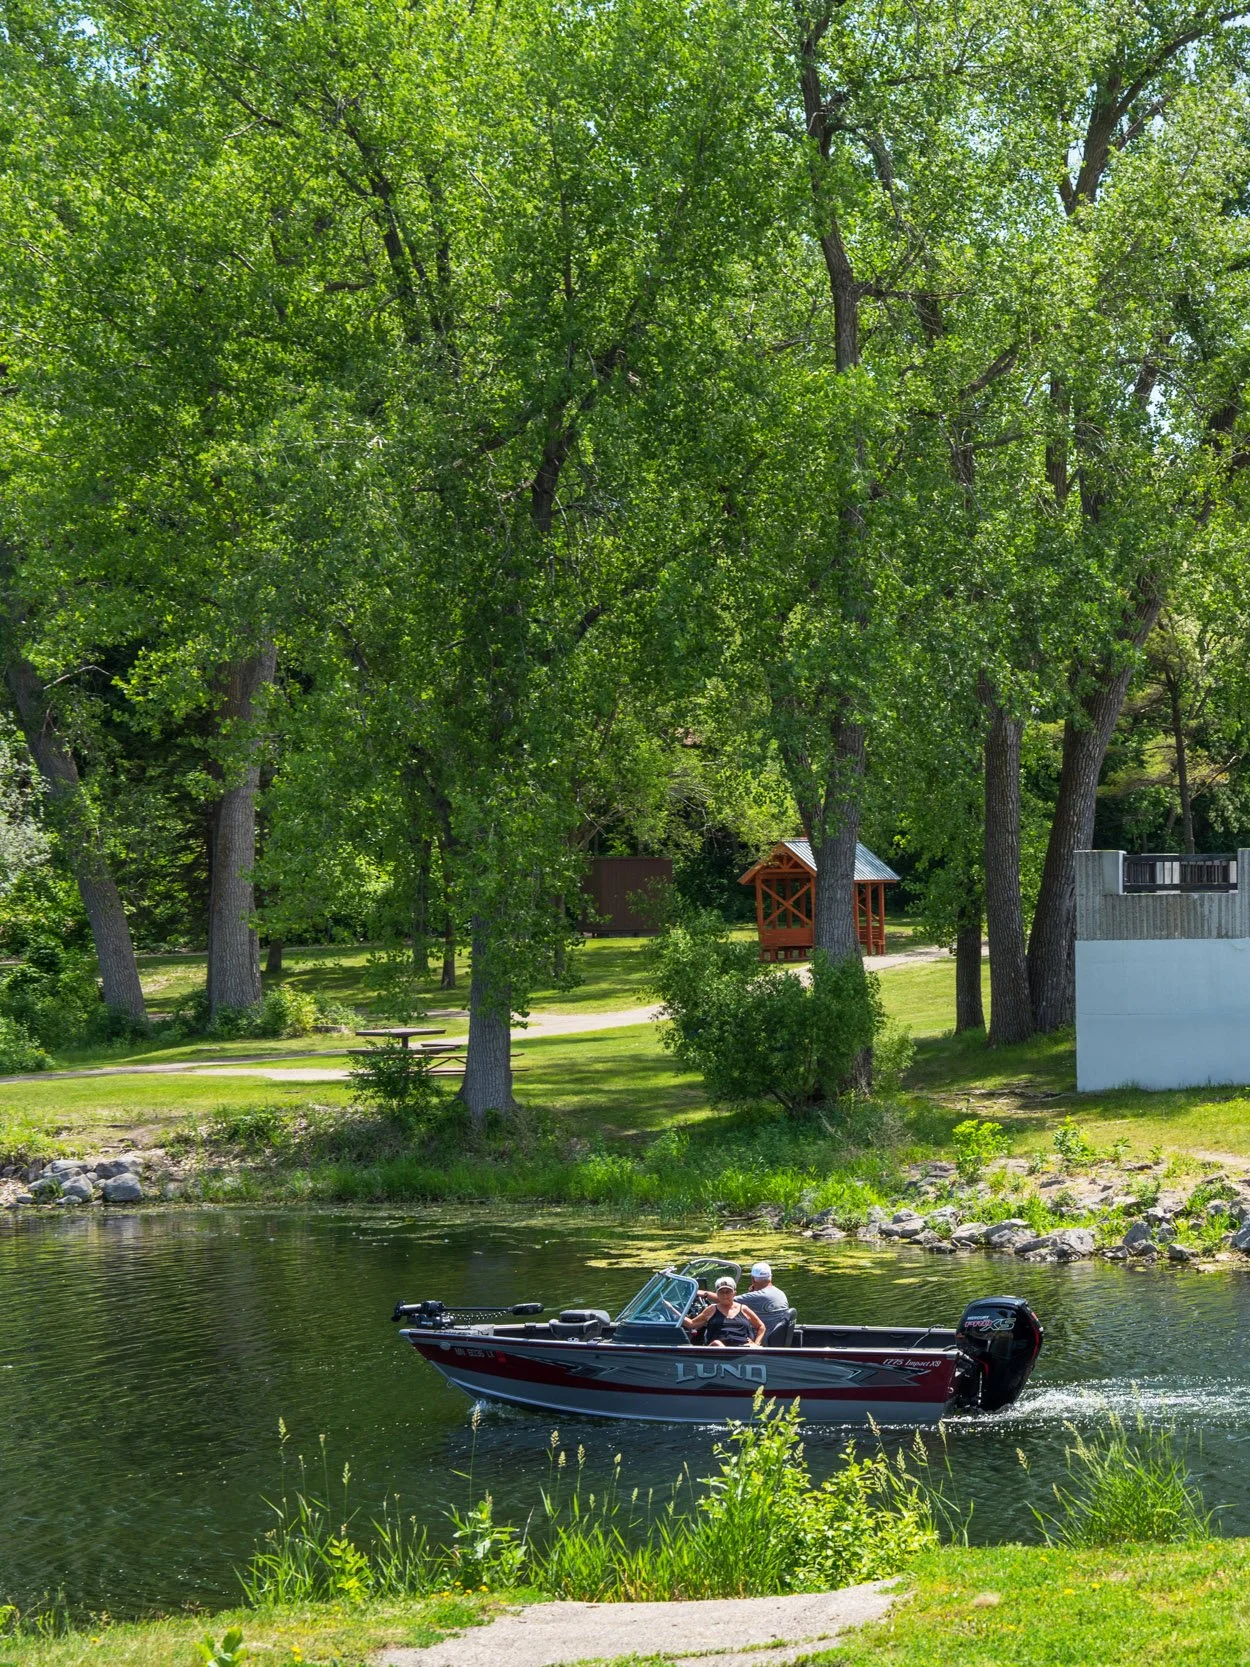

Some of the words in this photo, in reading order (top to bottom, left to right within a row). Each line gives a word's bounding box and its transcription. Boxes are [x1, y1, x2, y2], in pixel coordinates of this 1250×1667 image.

[979, 1318, 1017, 1331] XS
[905, 1359, 929, 1367] Impact
[675, 1363, 767, 1385] LUND
